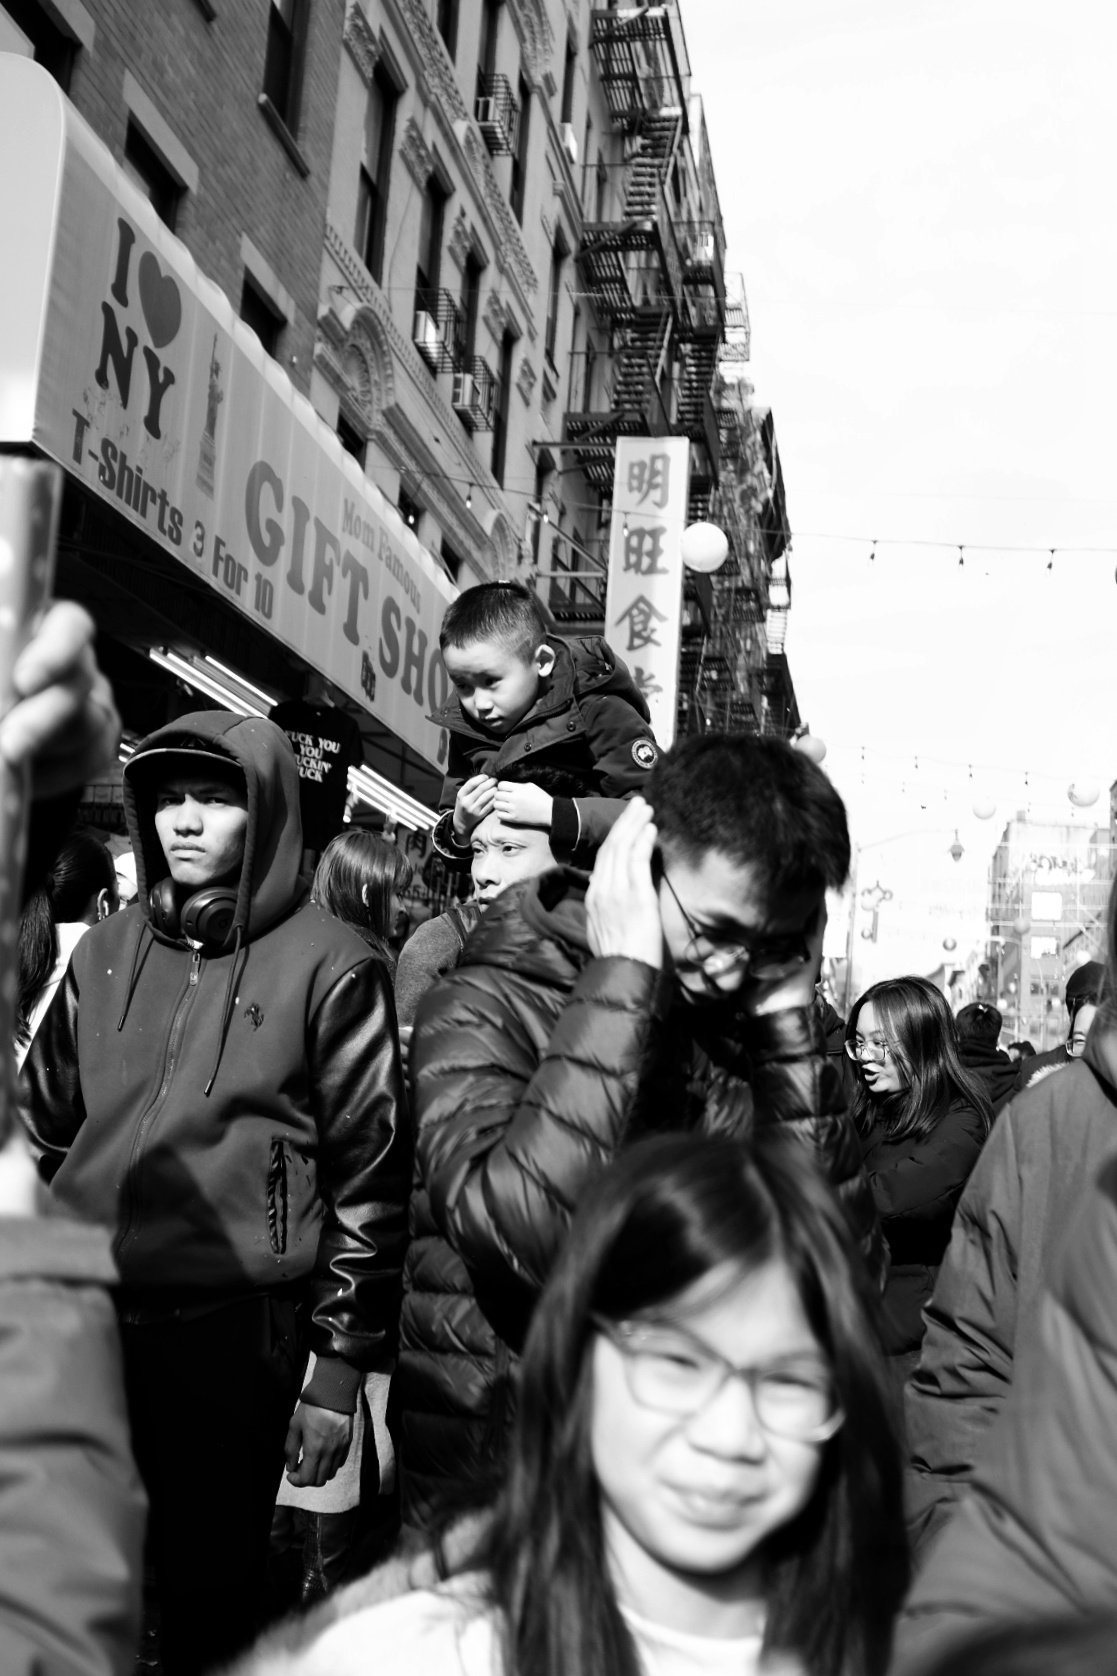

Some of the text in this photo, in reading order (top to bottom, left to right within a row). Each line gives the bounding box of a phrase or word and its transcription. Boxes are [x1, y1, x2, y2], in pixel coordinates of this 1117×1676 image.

[111, 217, 136, 308] I
[95, 301, 176, 440] NY
[72, 408, 274, 620] T-Shirts 3 For 10
[342, 498, 375, 553] Mom
[245, 460, 369, 646] GIFT
[294, 753, 332, 773] UCKIN'
[300, 743, 323, 760] YOU
[318, 737, 341, 754] YOU
[297, 765, 322, 783] UCK
